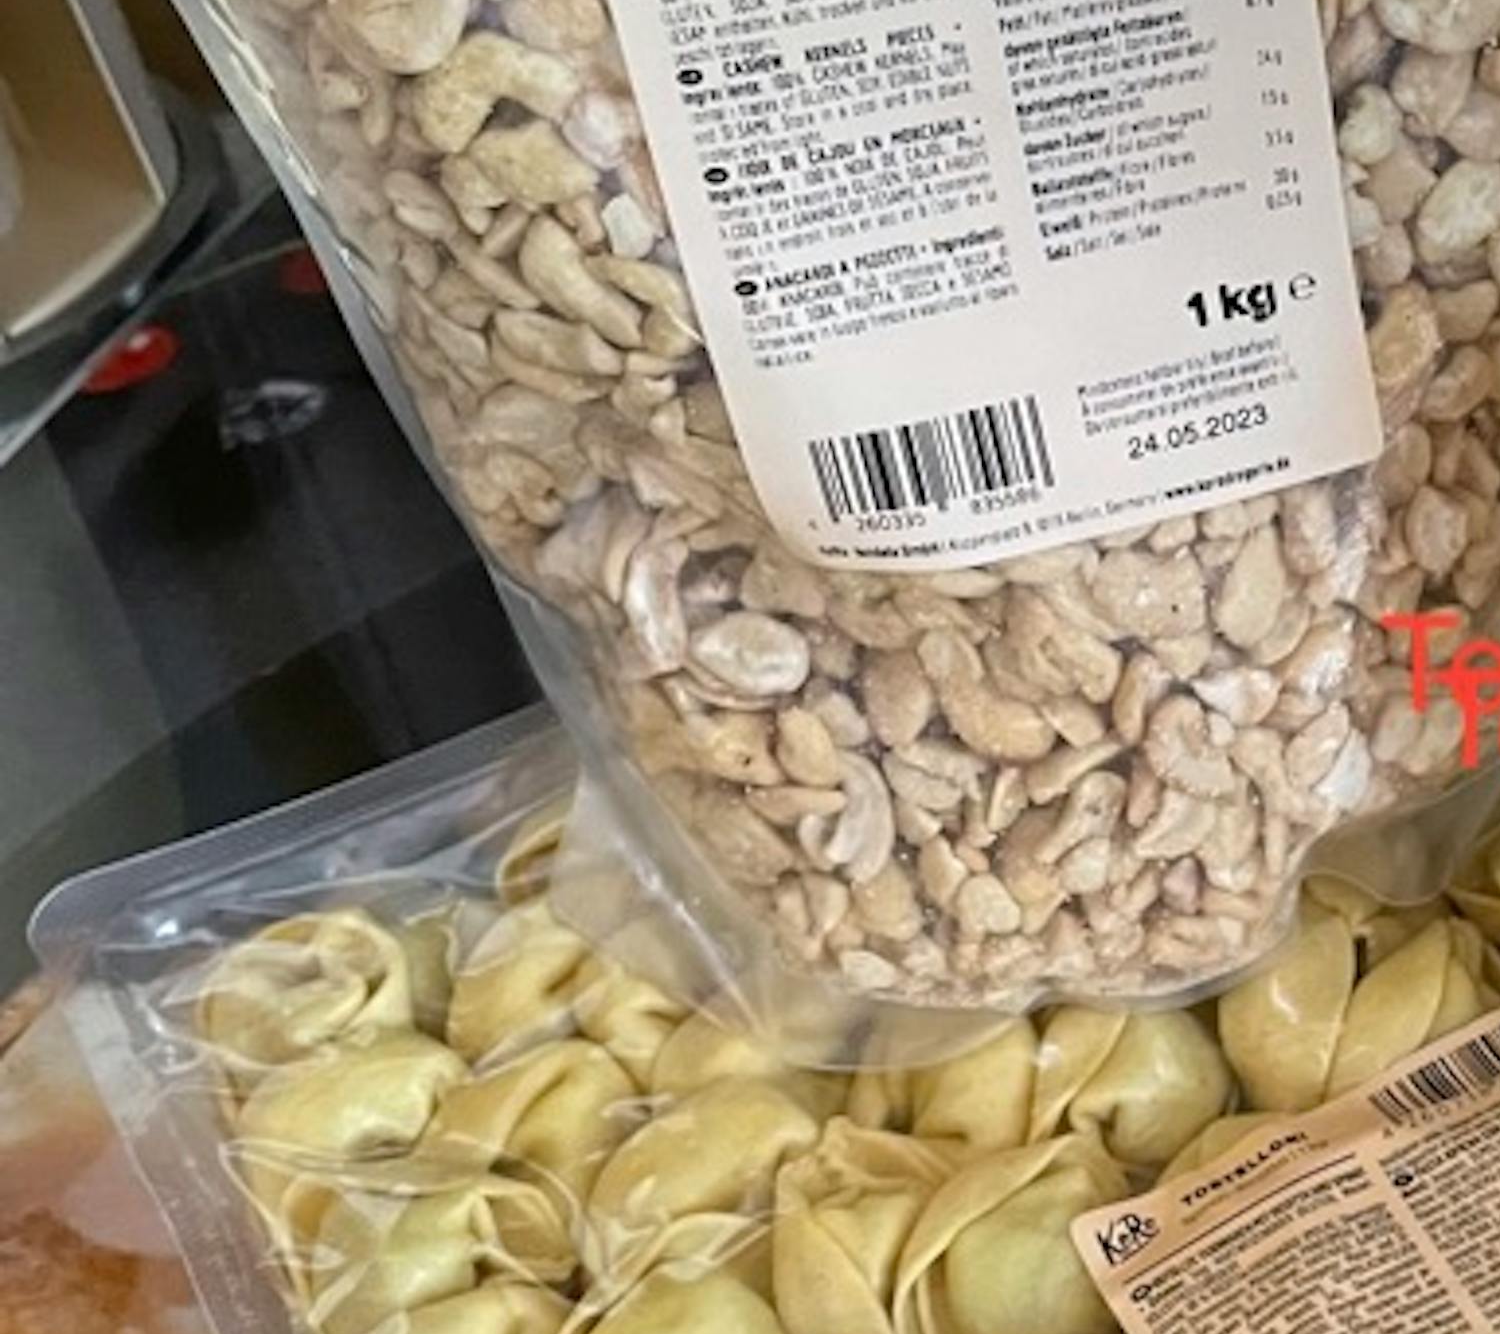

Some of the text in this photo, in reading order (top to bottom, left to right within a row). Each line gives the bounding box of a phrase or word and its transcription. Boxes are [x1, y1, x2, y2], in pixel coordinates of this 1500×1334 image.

[1187, 292, 1208, 327] 1
[1218, 282, 1277, 323] kg
[1128, 401, 1269, 460] 24.05.2023
[1180, 1130, 1309, 1209] TORTELLONI
[1096, 1212, 1160, 1268] KoRo
